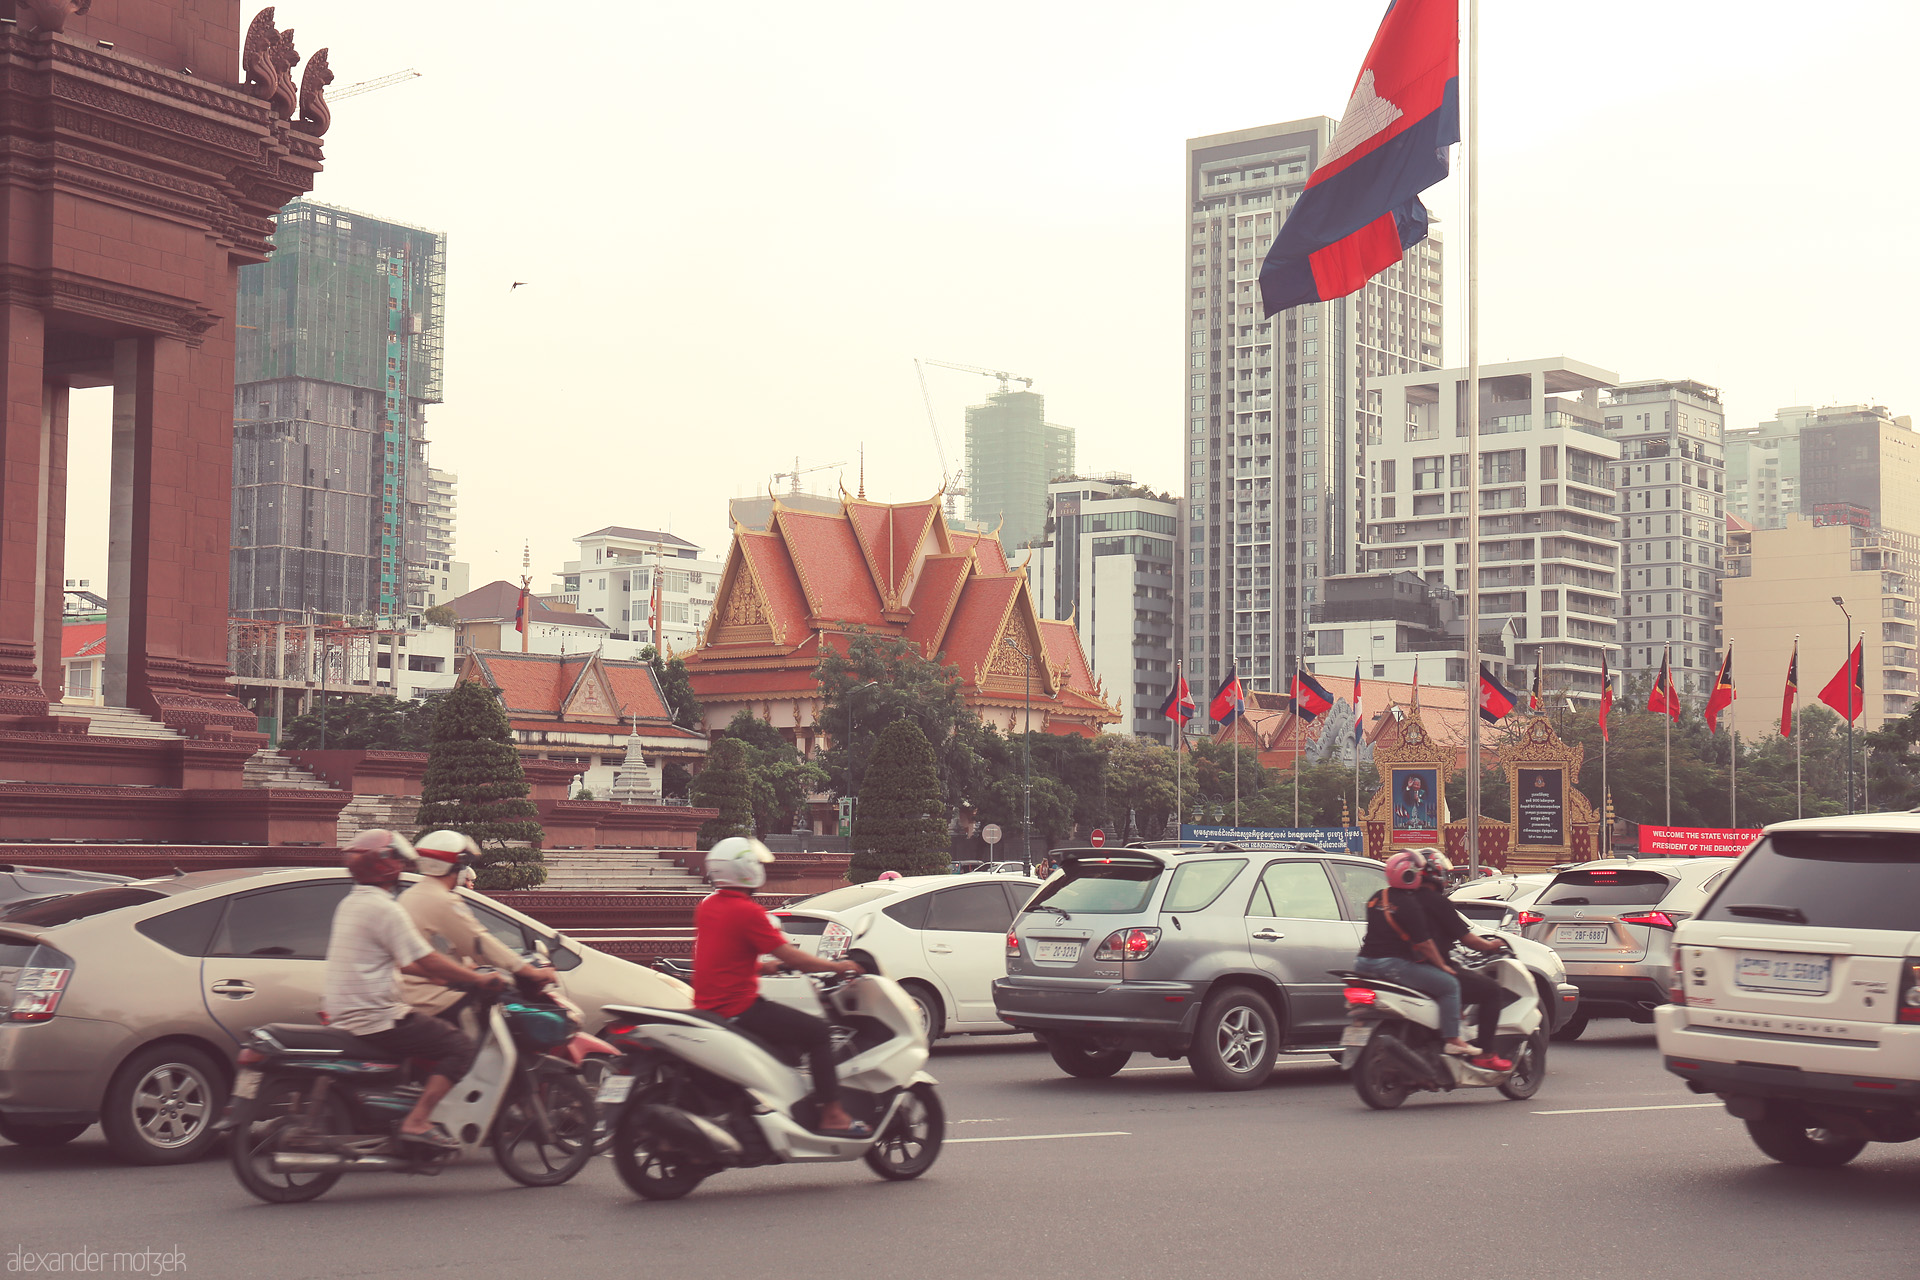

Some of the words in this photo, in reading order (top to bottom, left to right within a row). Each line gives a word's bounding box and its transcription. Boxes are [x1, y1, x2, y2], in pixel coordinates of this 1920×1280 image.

[1652, 830, 1684, 839] WELCOME
[1700, 832, 1721, 840] STATE
[1652, 841, 1688, 850] PRESIDENT
[1689, 843, 1698, 851] OF
[1575, 931, 1605, 940] 2BF-6887
[1714, 1015, 1772, 1028] RANGE
[1783, 1022, 1849, 1034] ROVER
